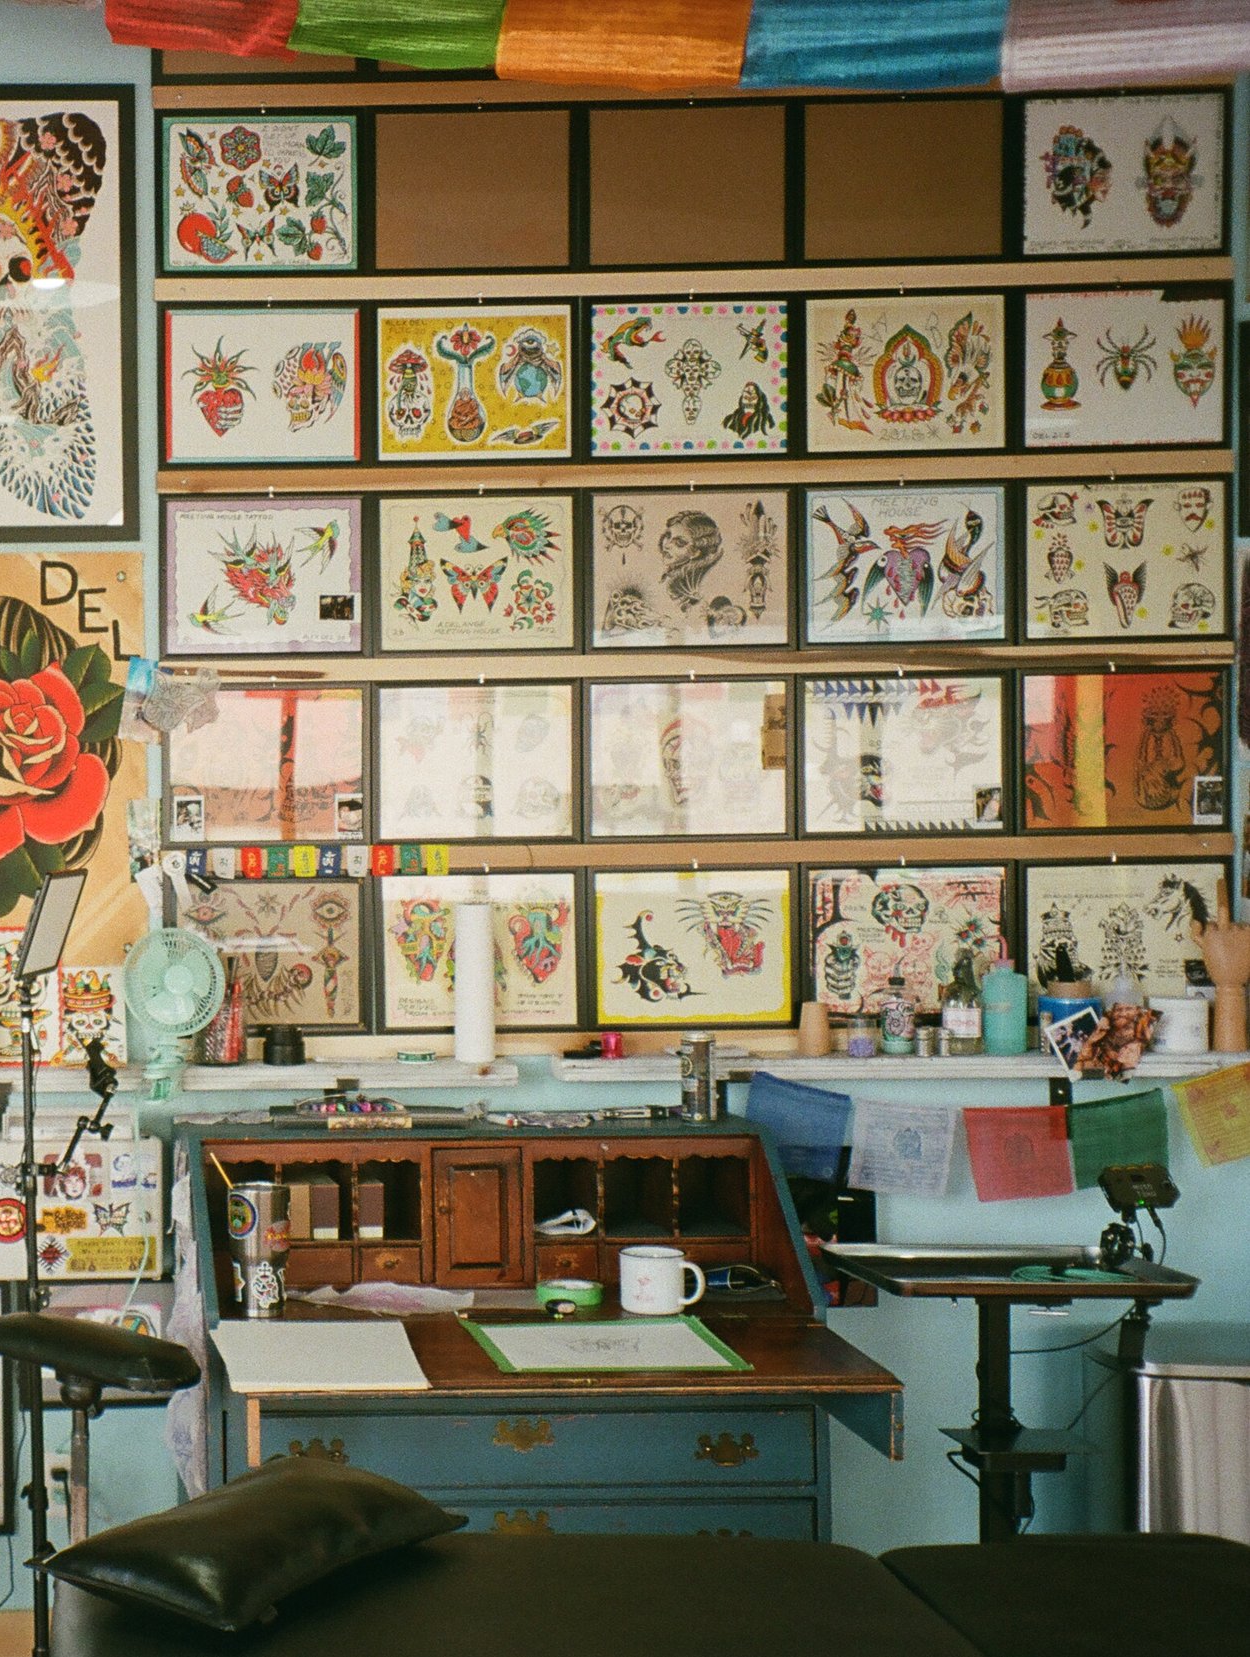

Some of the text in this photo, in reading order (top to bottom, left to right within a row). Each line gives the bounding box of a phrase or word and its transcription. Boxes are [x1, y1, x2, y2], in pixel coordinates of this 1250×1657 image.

[871, 496, 940, 508] MEETING
[878, 505, 922, 518] HOUSE
[40, 561, 140, 662] DEL
